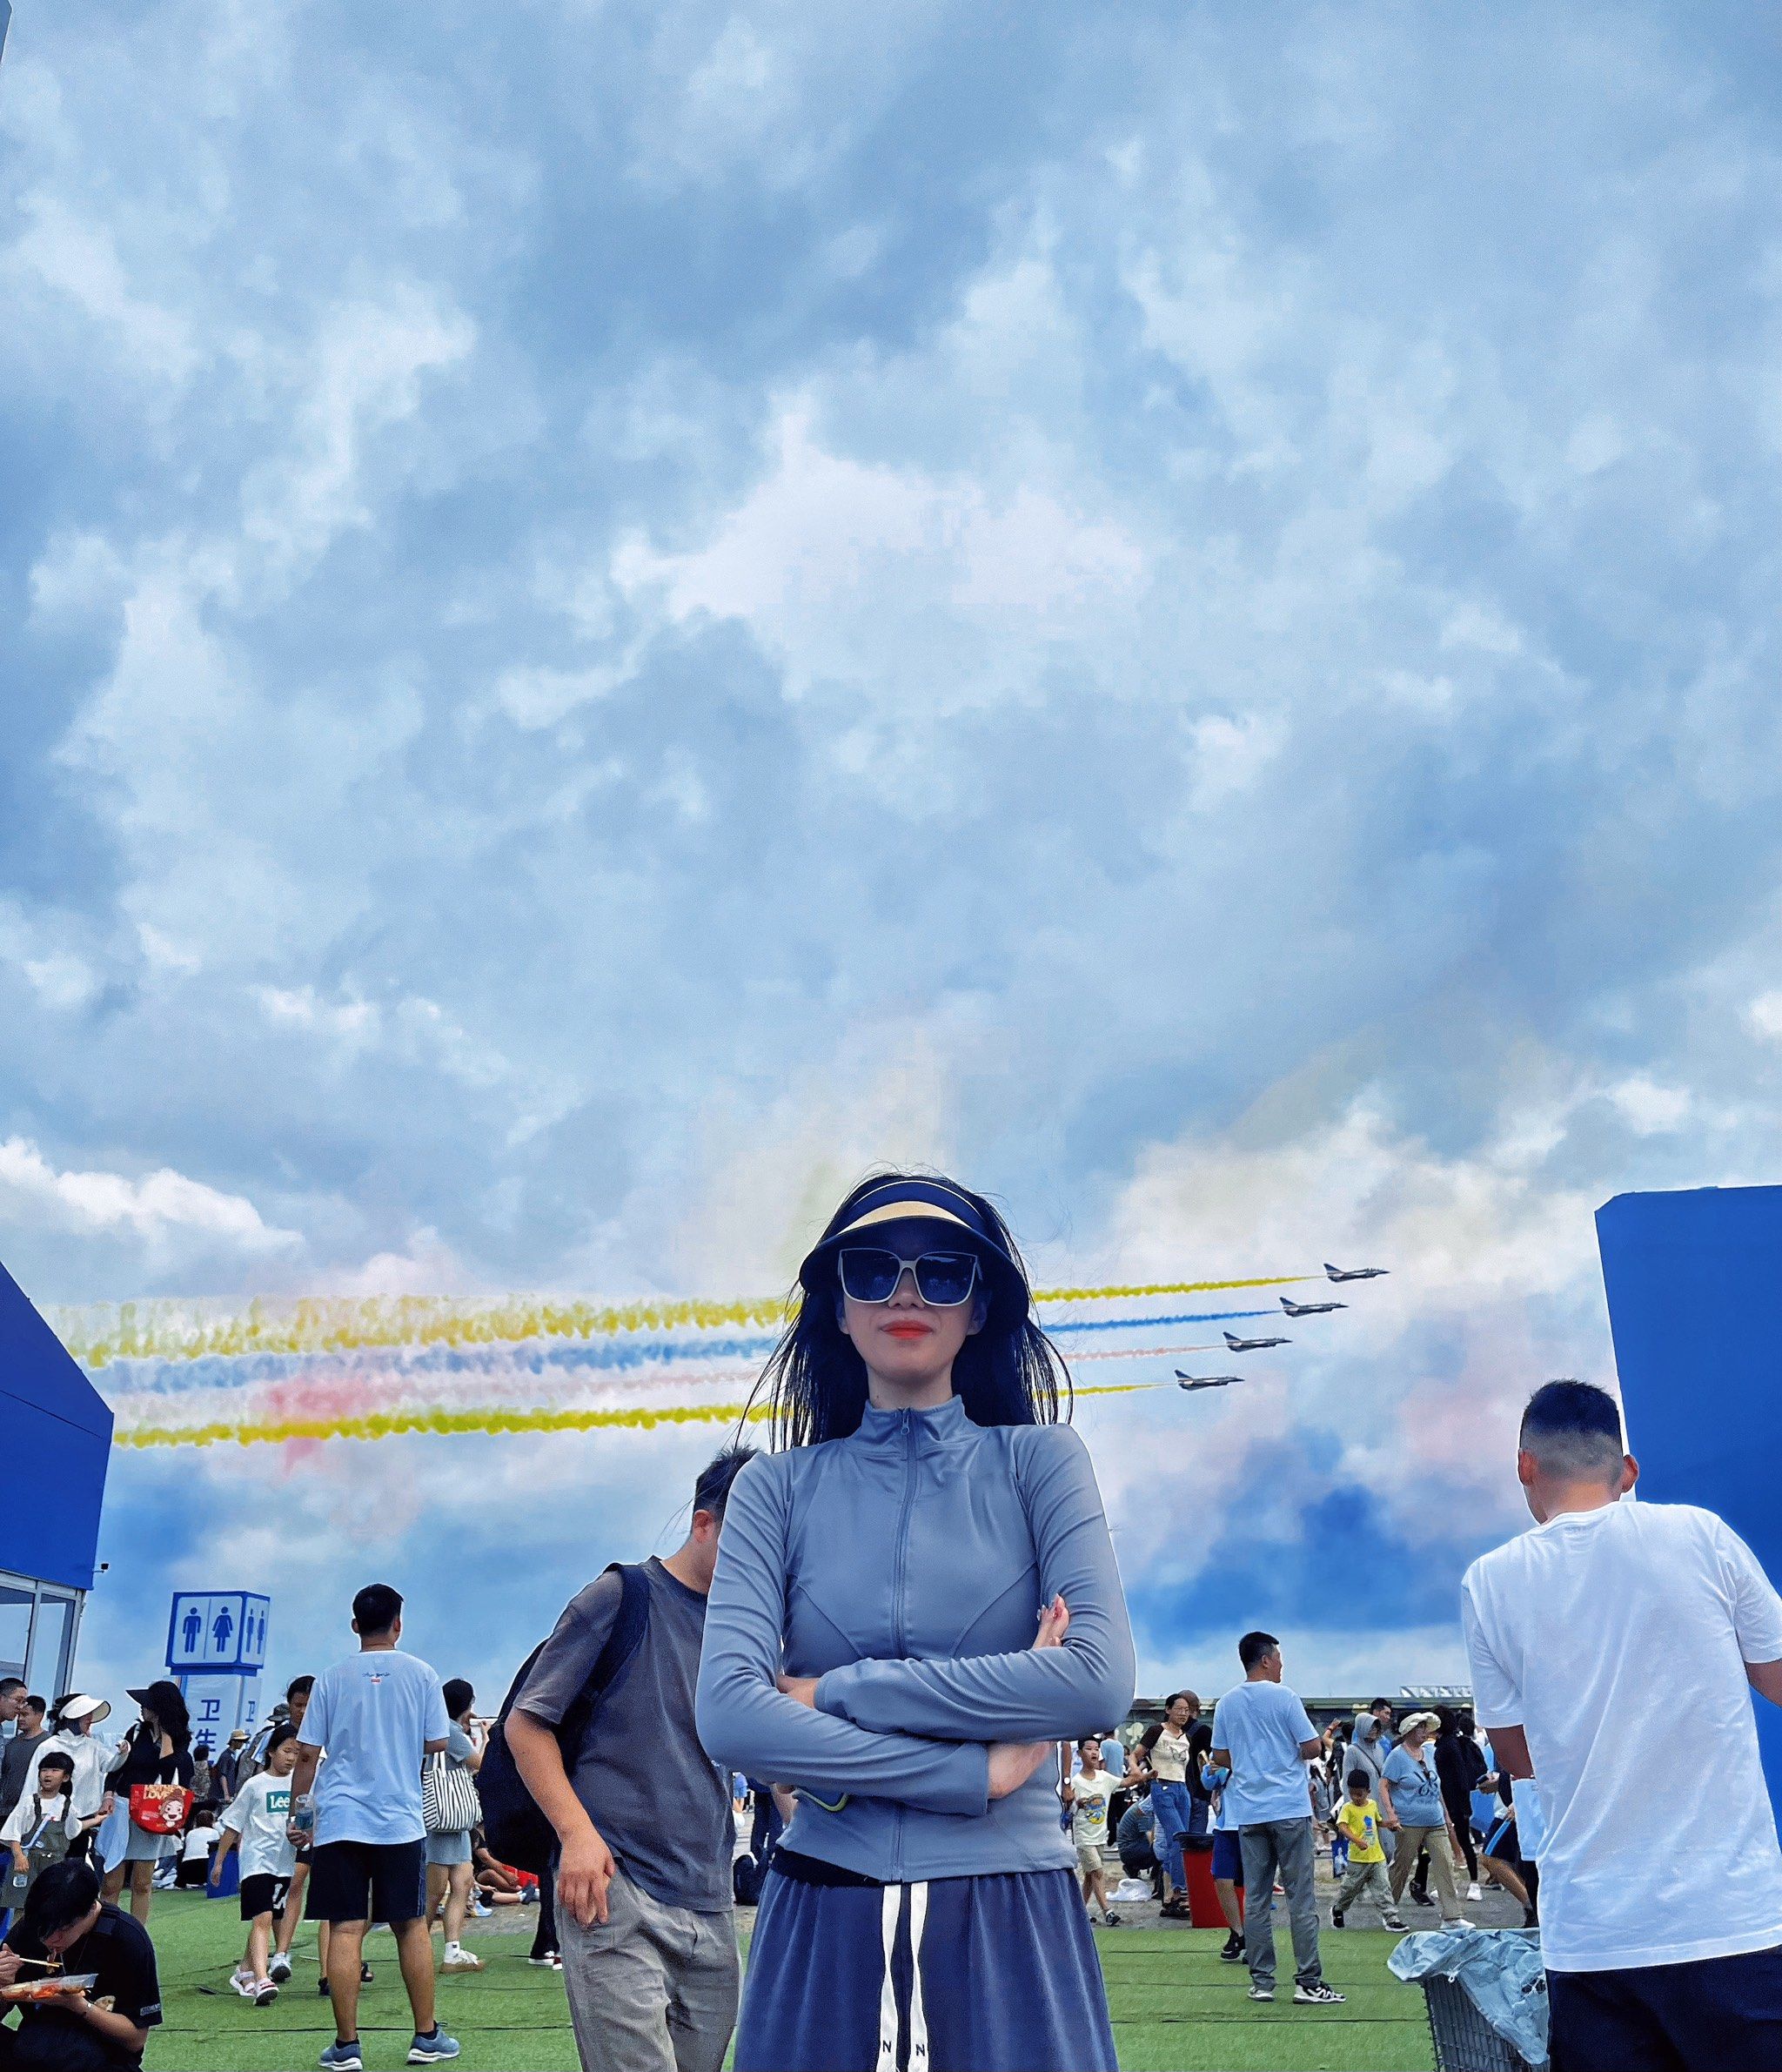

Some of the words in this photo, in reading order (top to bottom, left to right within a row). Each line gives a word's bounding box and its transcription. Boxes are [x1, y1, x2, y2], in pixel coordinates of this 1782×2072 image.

[270, 1794, 291, 1809] Lee
[882, 2040, 892, 2053] N
[915, 2043, 926, 2056] N
